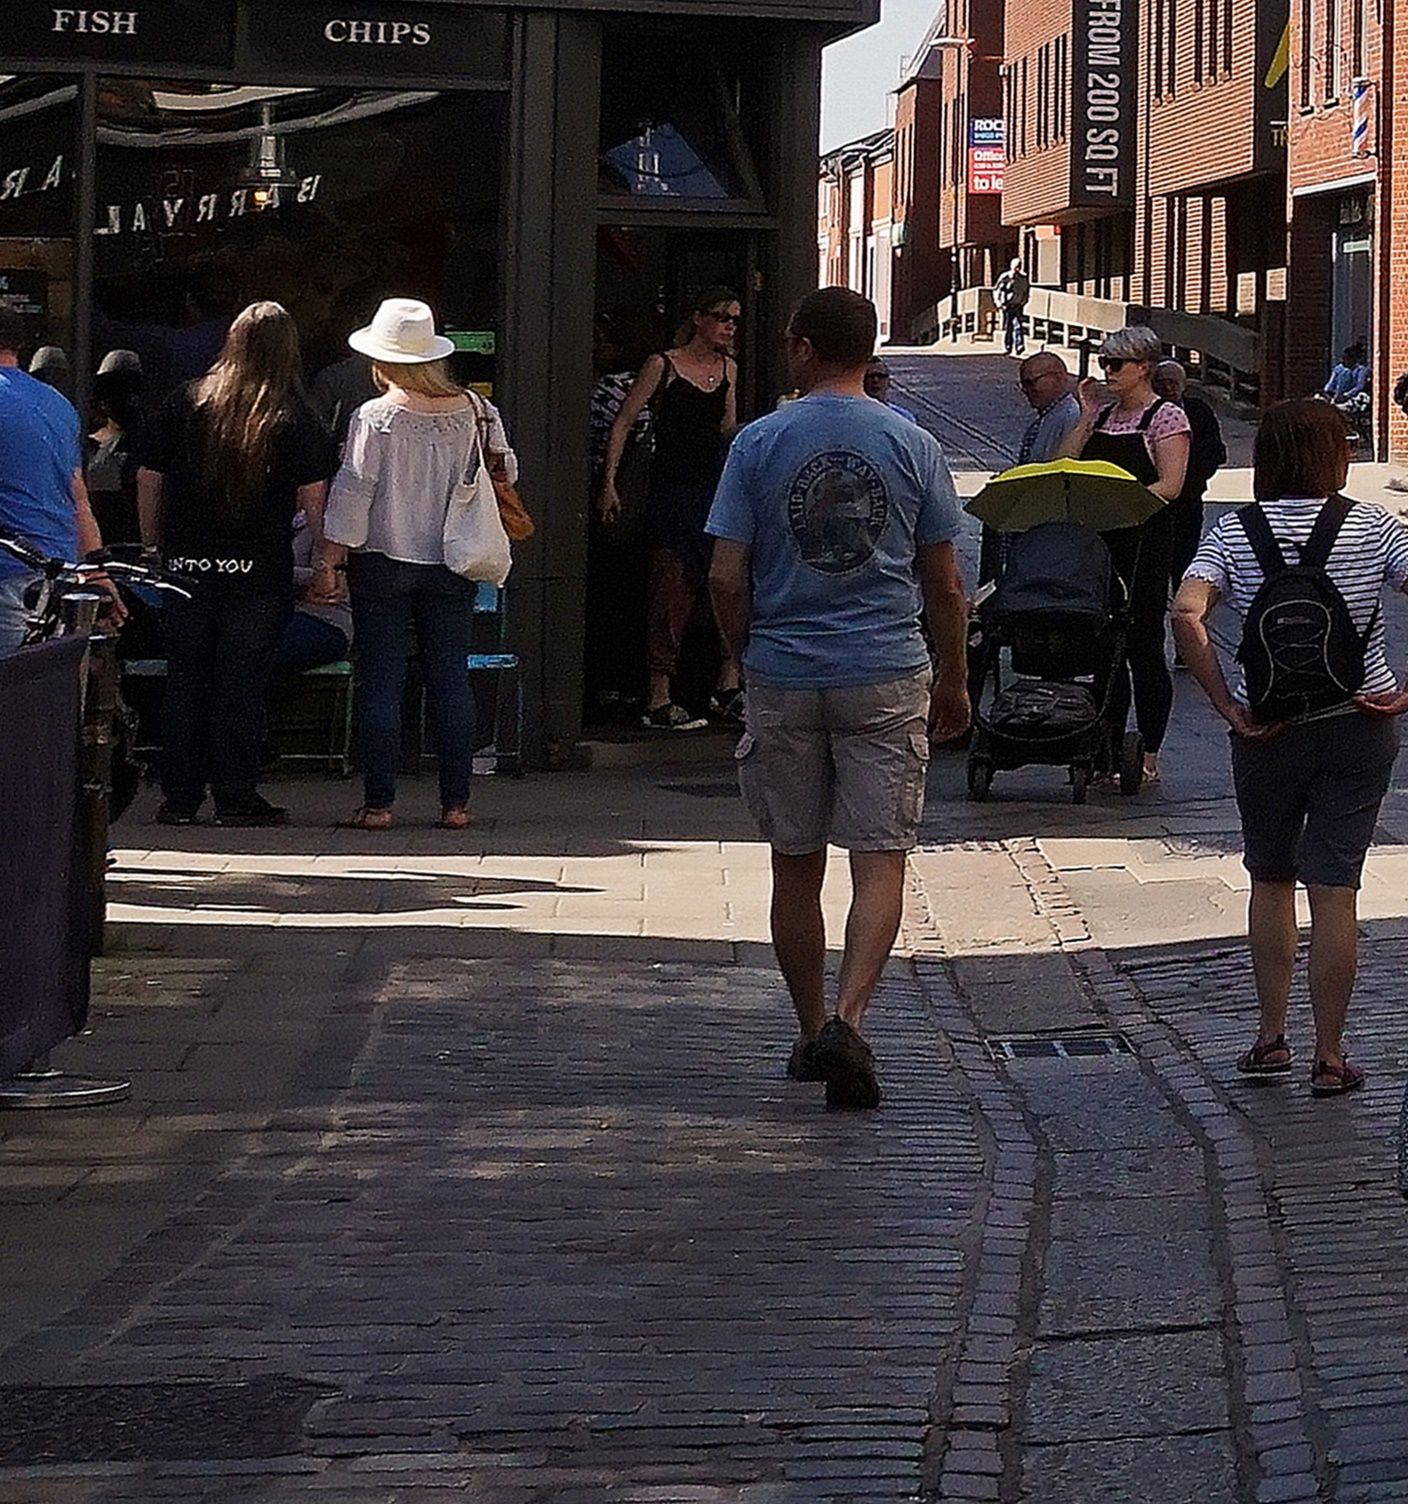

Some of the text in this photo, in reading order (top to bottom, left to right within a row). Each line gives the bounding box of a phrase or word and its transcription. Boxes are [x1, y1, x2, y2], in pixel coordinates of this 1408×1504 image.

[53, 9, 138, 36] FISH
[324, 19, 430, 46] CHIPS
[1086, 72, 1121, 121] 200
[974, 119, 1005, 132] ROC
[1084, 128, 1121, 160] SQ
[973, 174, 1005, 190] to le
[1085, 167, 1119, 196] FT
[215, 557, 253, 574] YOU
